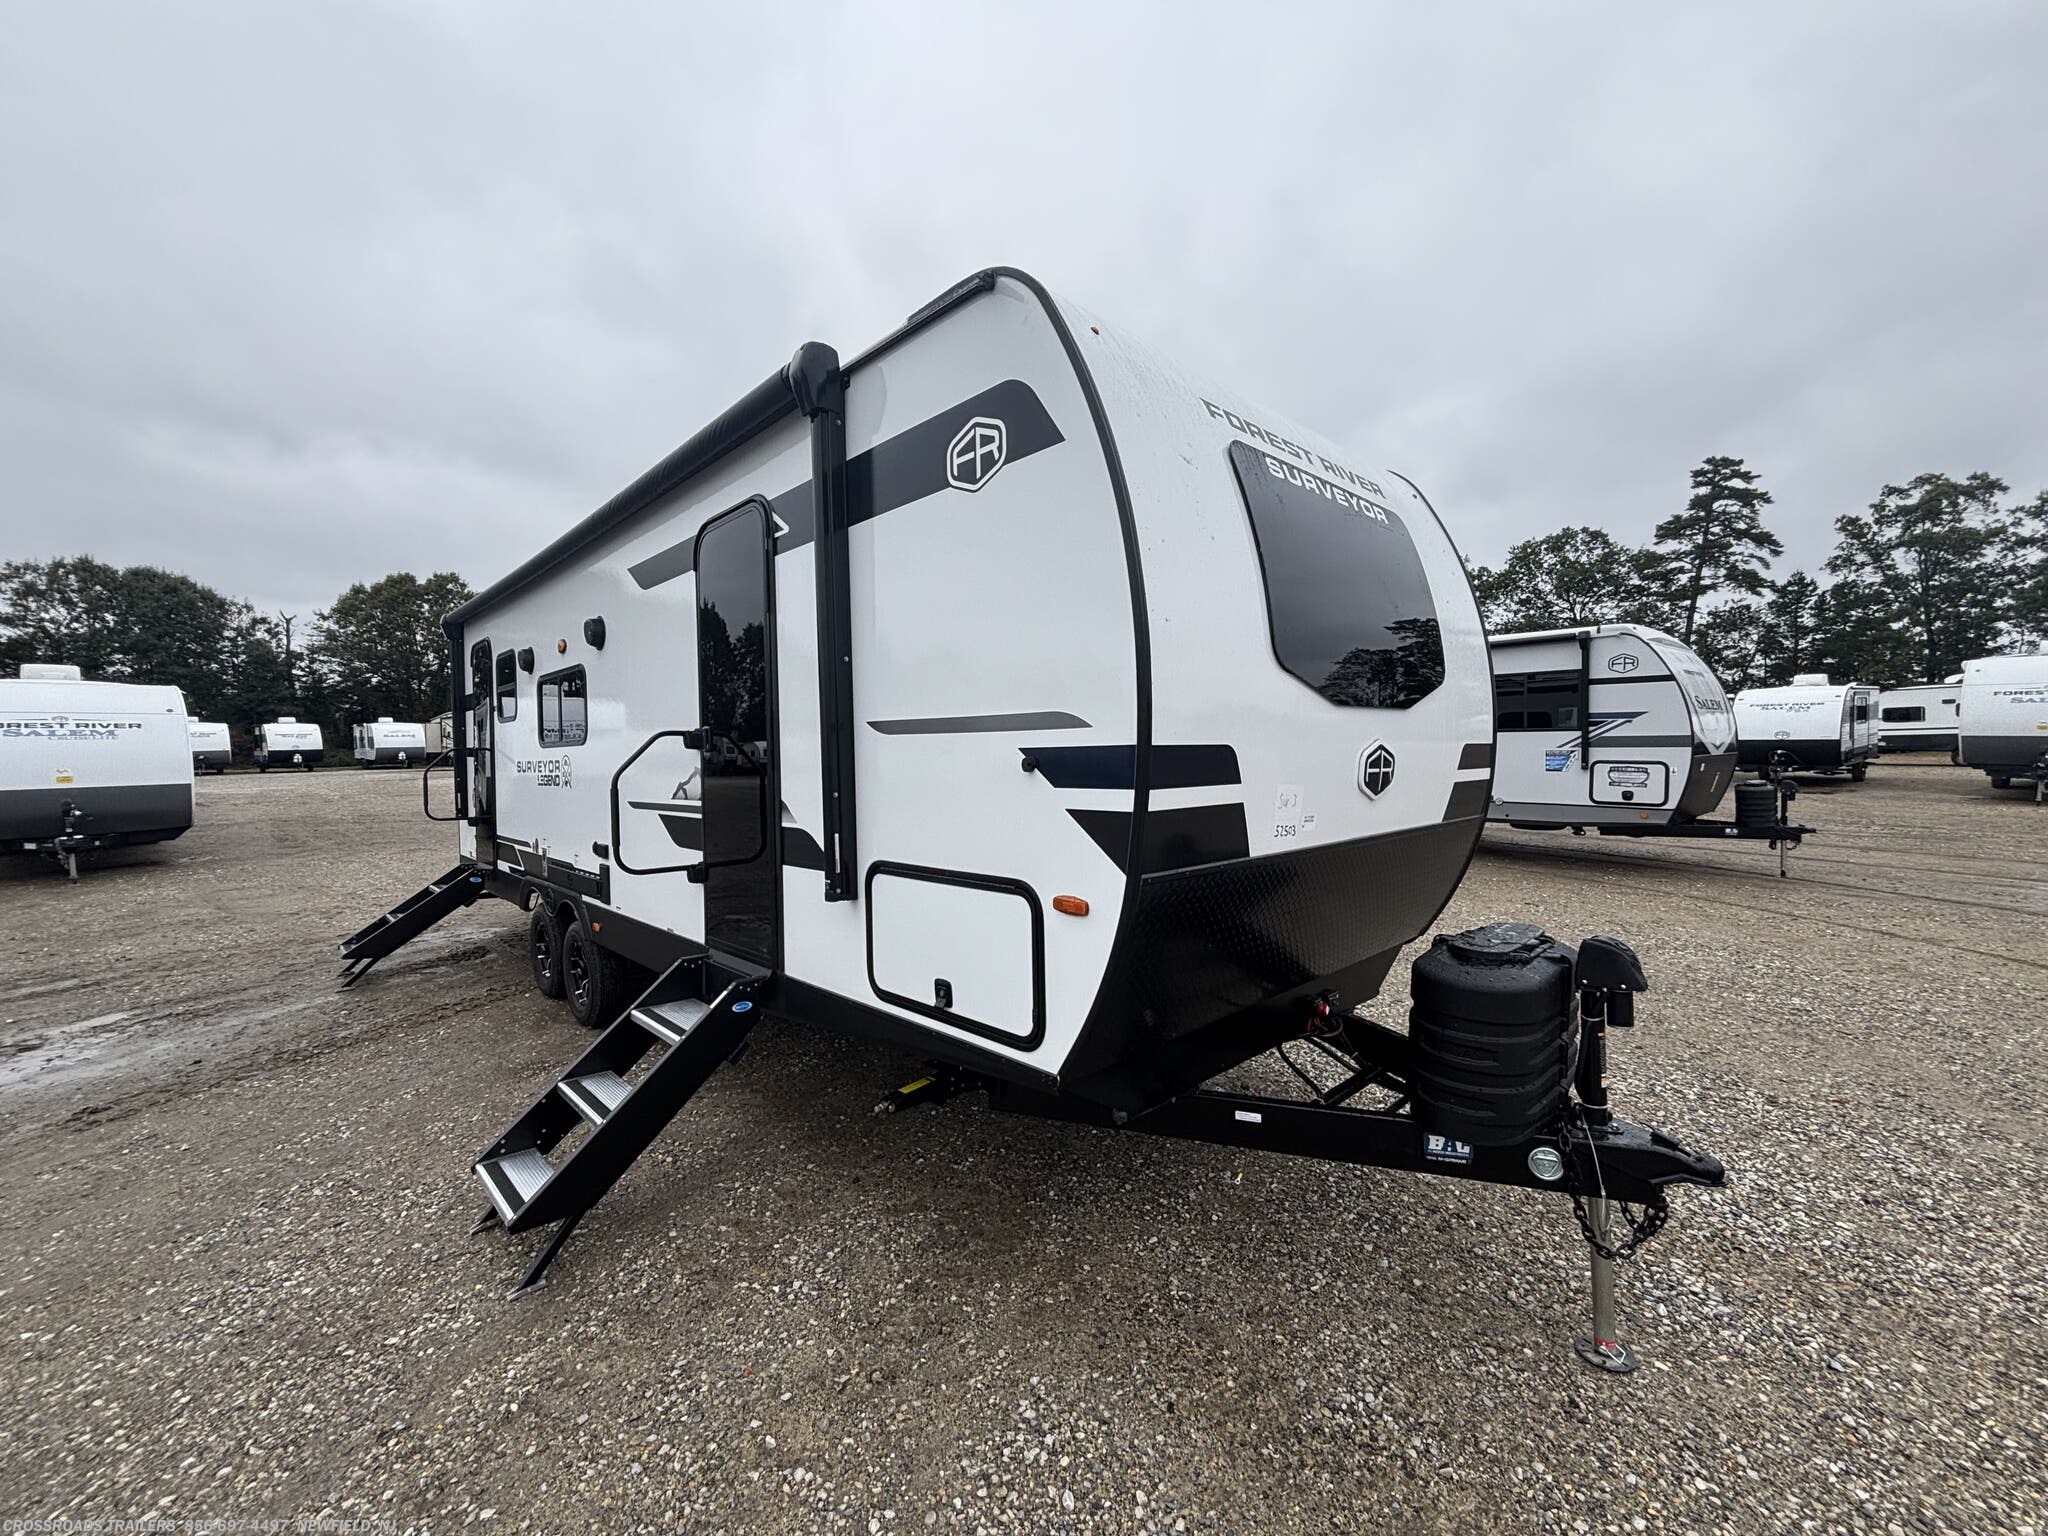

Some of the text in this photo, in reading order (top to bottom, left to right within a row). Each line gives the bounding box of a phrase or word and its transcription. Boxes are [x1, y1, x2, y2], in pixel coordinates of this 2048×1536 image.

[1200, 397, 1387, 499] FOREST RIVER
[1264, 456, 1390, 524] SURVEYOR
[2, 729, 118, 737] SALEM
[516, 760, 561, 773] SURVEYOR
[537, 774, 561, 787] LEGEND
